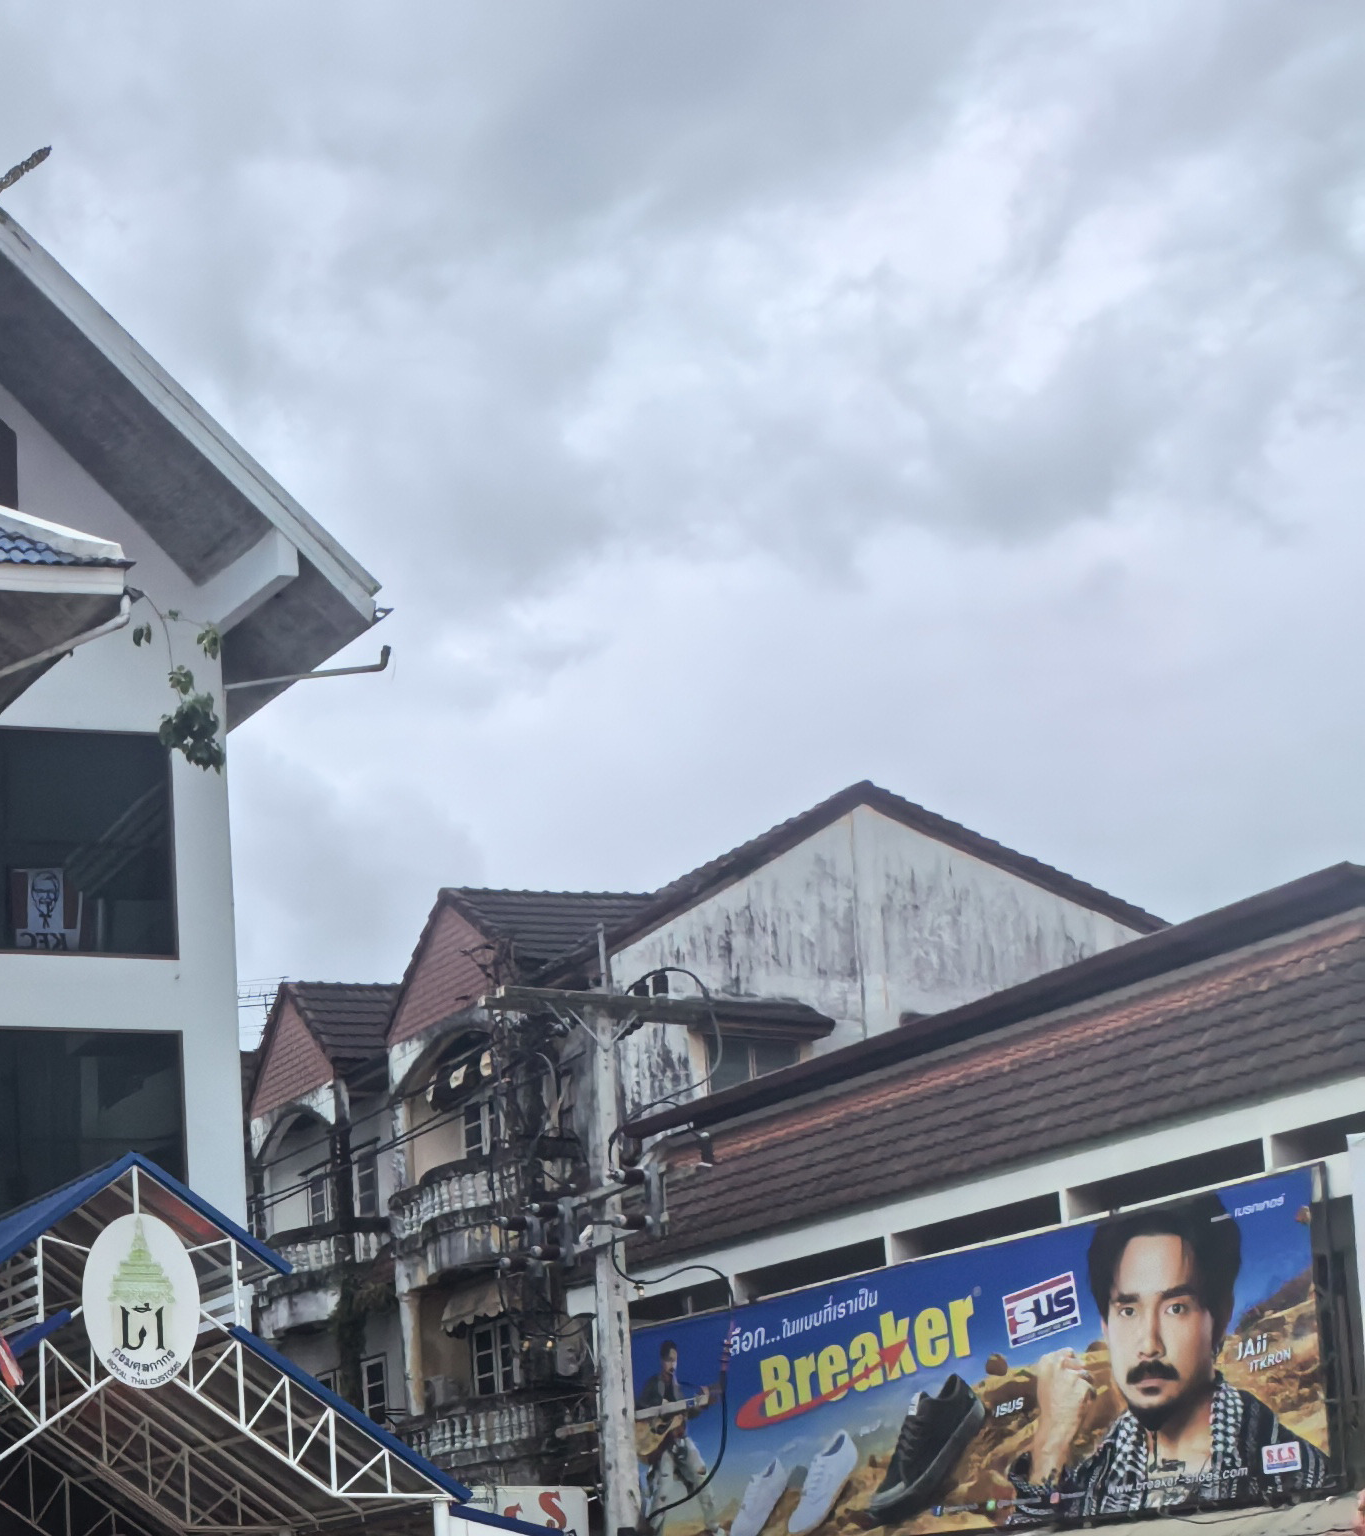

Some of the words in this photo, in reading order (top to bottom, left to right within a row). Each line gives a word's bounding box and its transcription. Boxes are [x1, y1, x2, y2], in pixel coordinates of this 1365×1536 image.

[759, 1294, 975, 1418] Breaker
[107, 1358, 128, 1380] ROYAL
[130, 1376, 149, 1386] THAI
[150, 1361, 182, 1385] CUSTOMS
[1107, 1465, 1249, 1495] www.breaker-shoes.com
